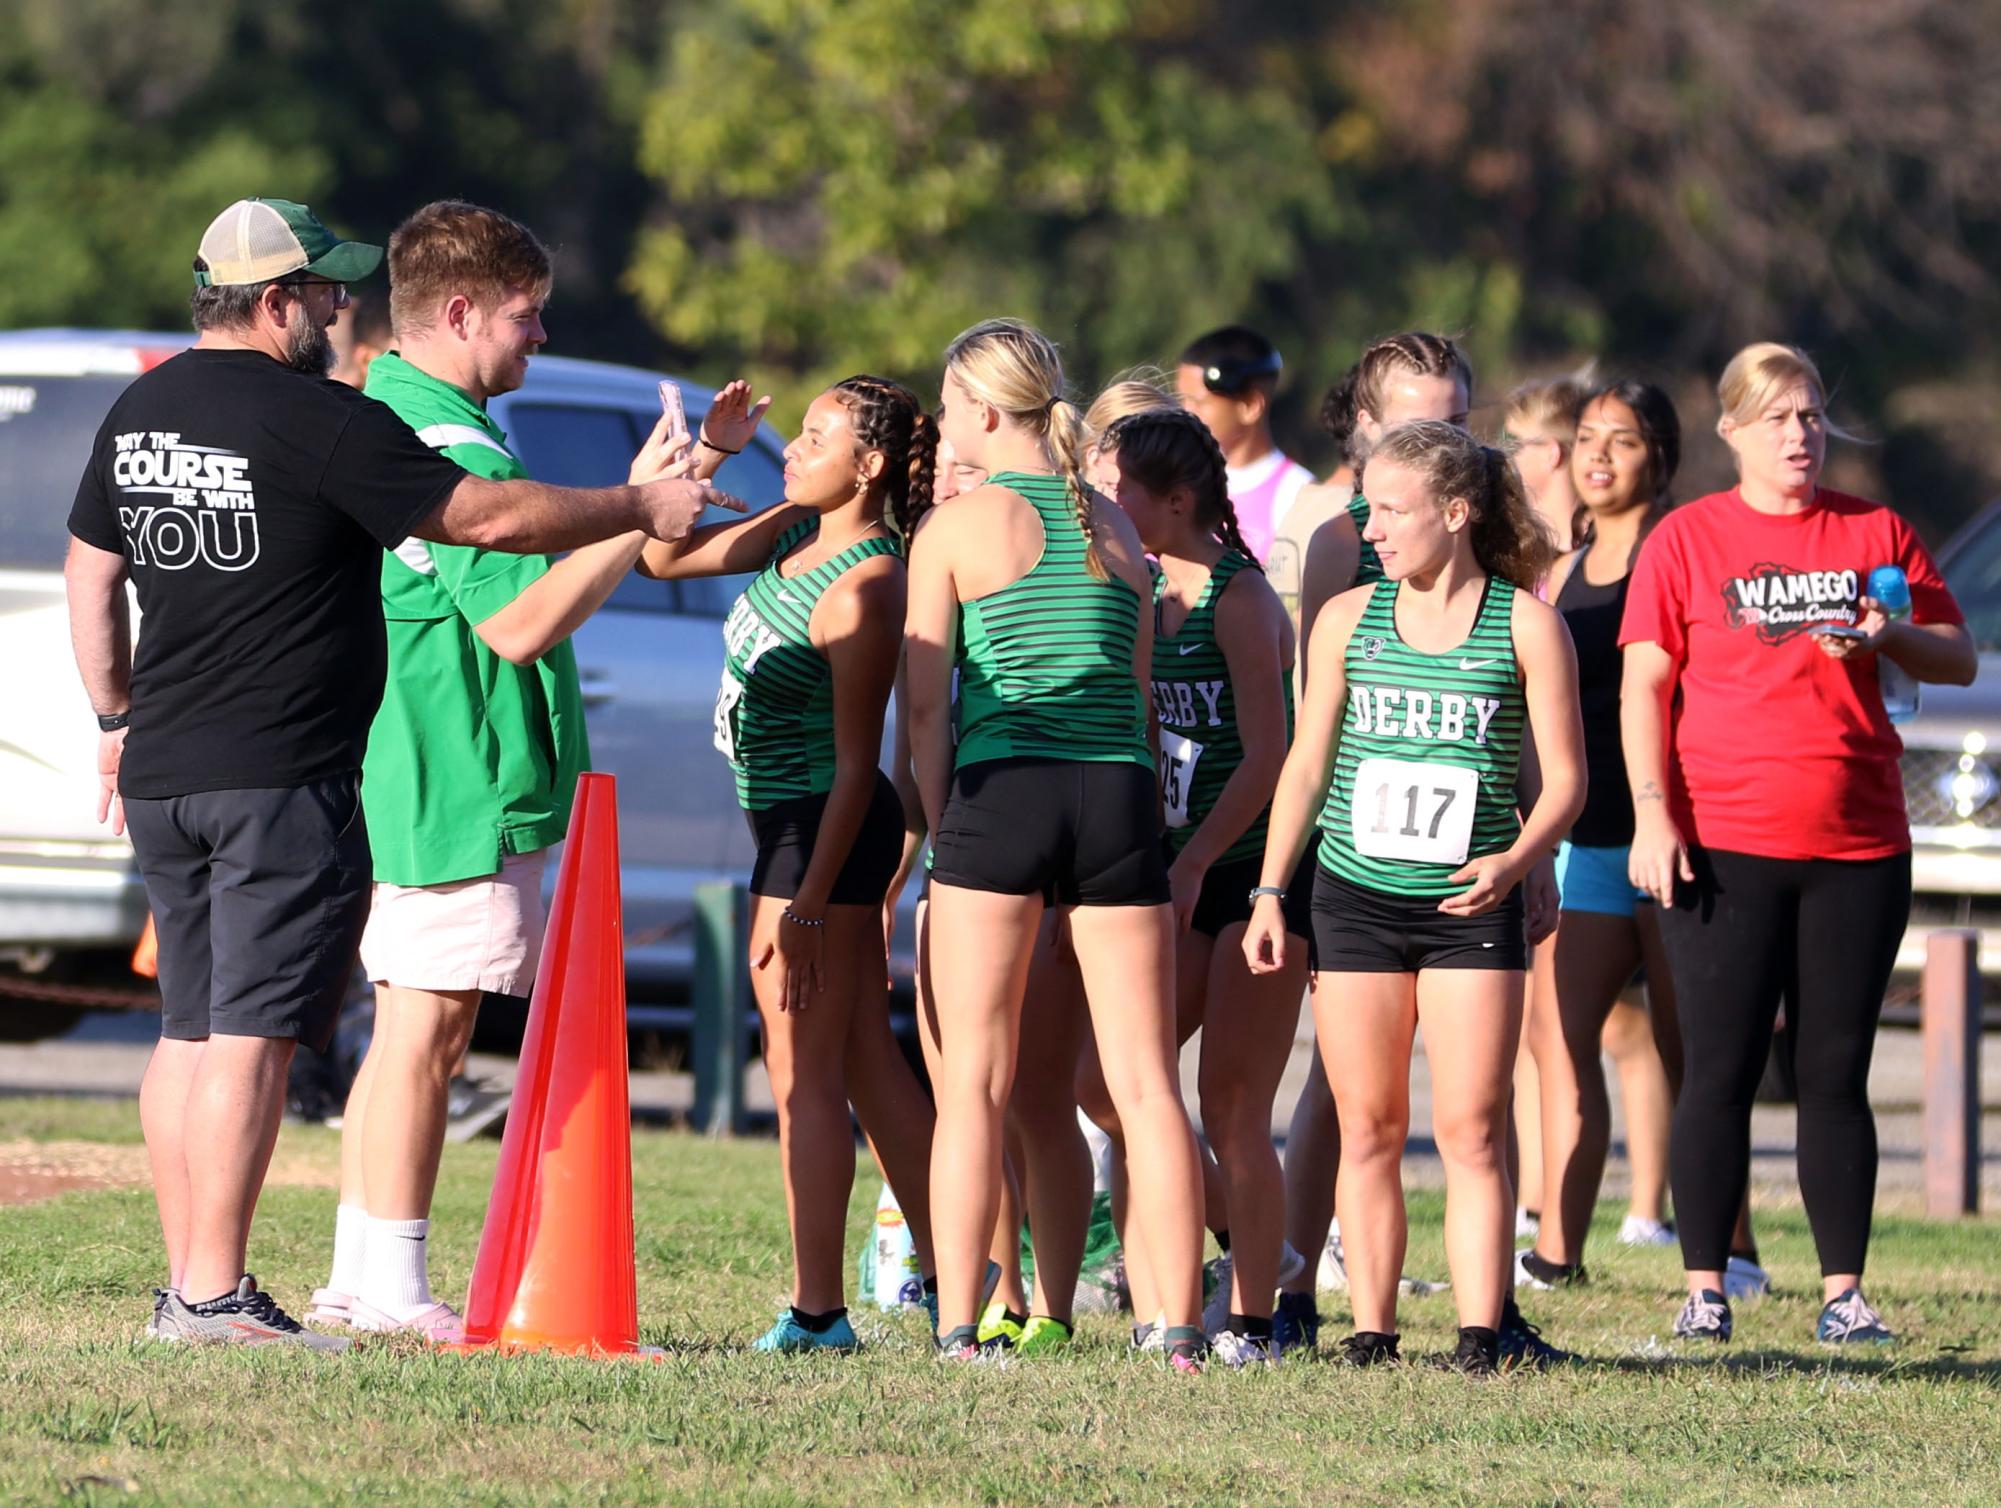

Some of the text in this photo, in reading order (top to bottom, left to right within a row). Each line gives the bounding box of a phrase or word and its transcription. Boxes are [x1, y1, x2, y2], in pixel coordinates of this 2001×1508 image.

[115, 431, 181, 452] MAY THE
[113, 449, 253, 491] COURSE
[172, 489, 256, 509] BE WITH
[118, 506, 260, 572] YOU
[1735, 569, 1858, 607] WAMEGO
[1767, 603, 1857, 626] Cross Country
[1350, 685, 1501, 745] DERBY
[1370, 782, 1456, 839] 117
